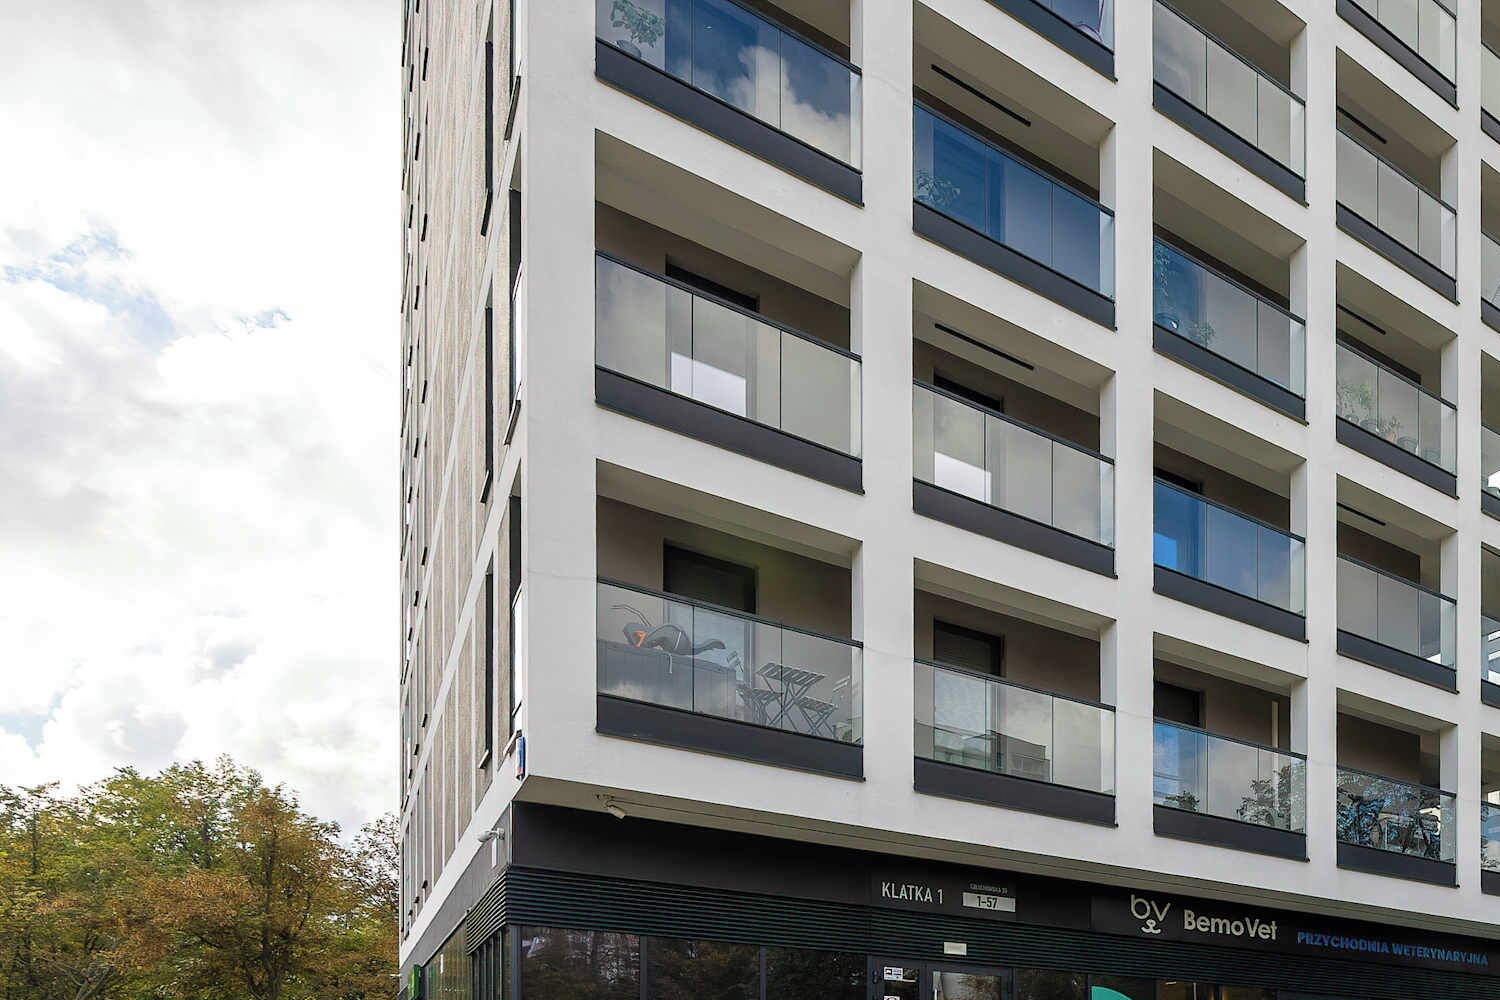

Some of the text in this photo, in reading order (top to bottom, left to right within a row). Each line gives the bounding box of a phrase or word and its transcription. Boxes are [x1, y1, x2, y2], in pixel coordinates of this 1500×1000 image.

[881, 882, 943, 904] KLATKA 1
[977, 896, 999, 908] 1-57
[1184, 909, 1278, 940] BemoVet
[1297, 931, 1489, 967] PRZYCHODNIA WETERYNARYJNA
